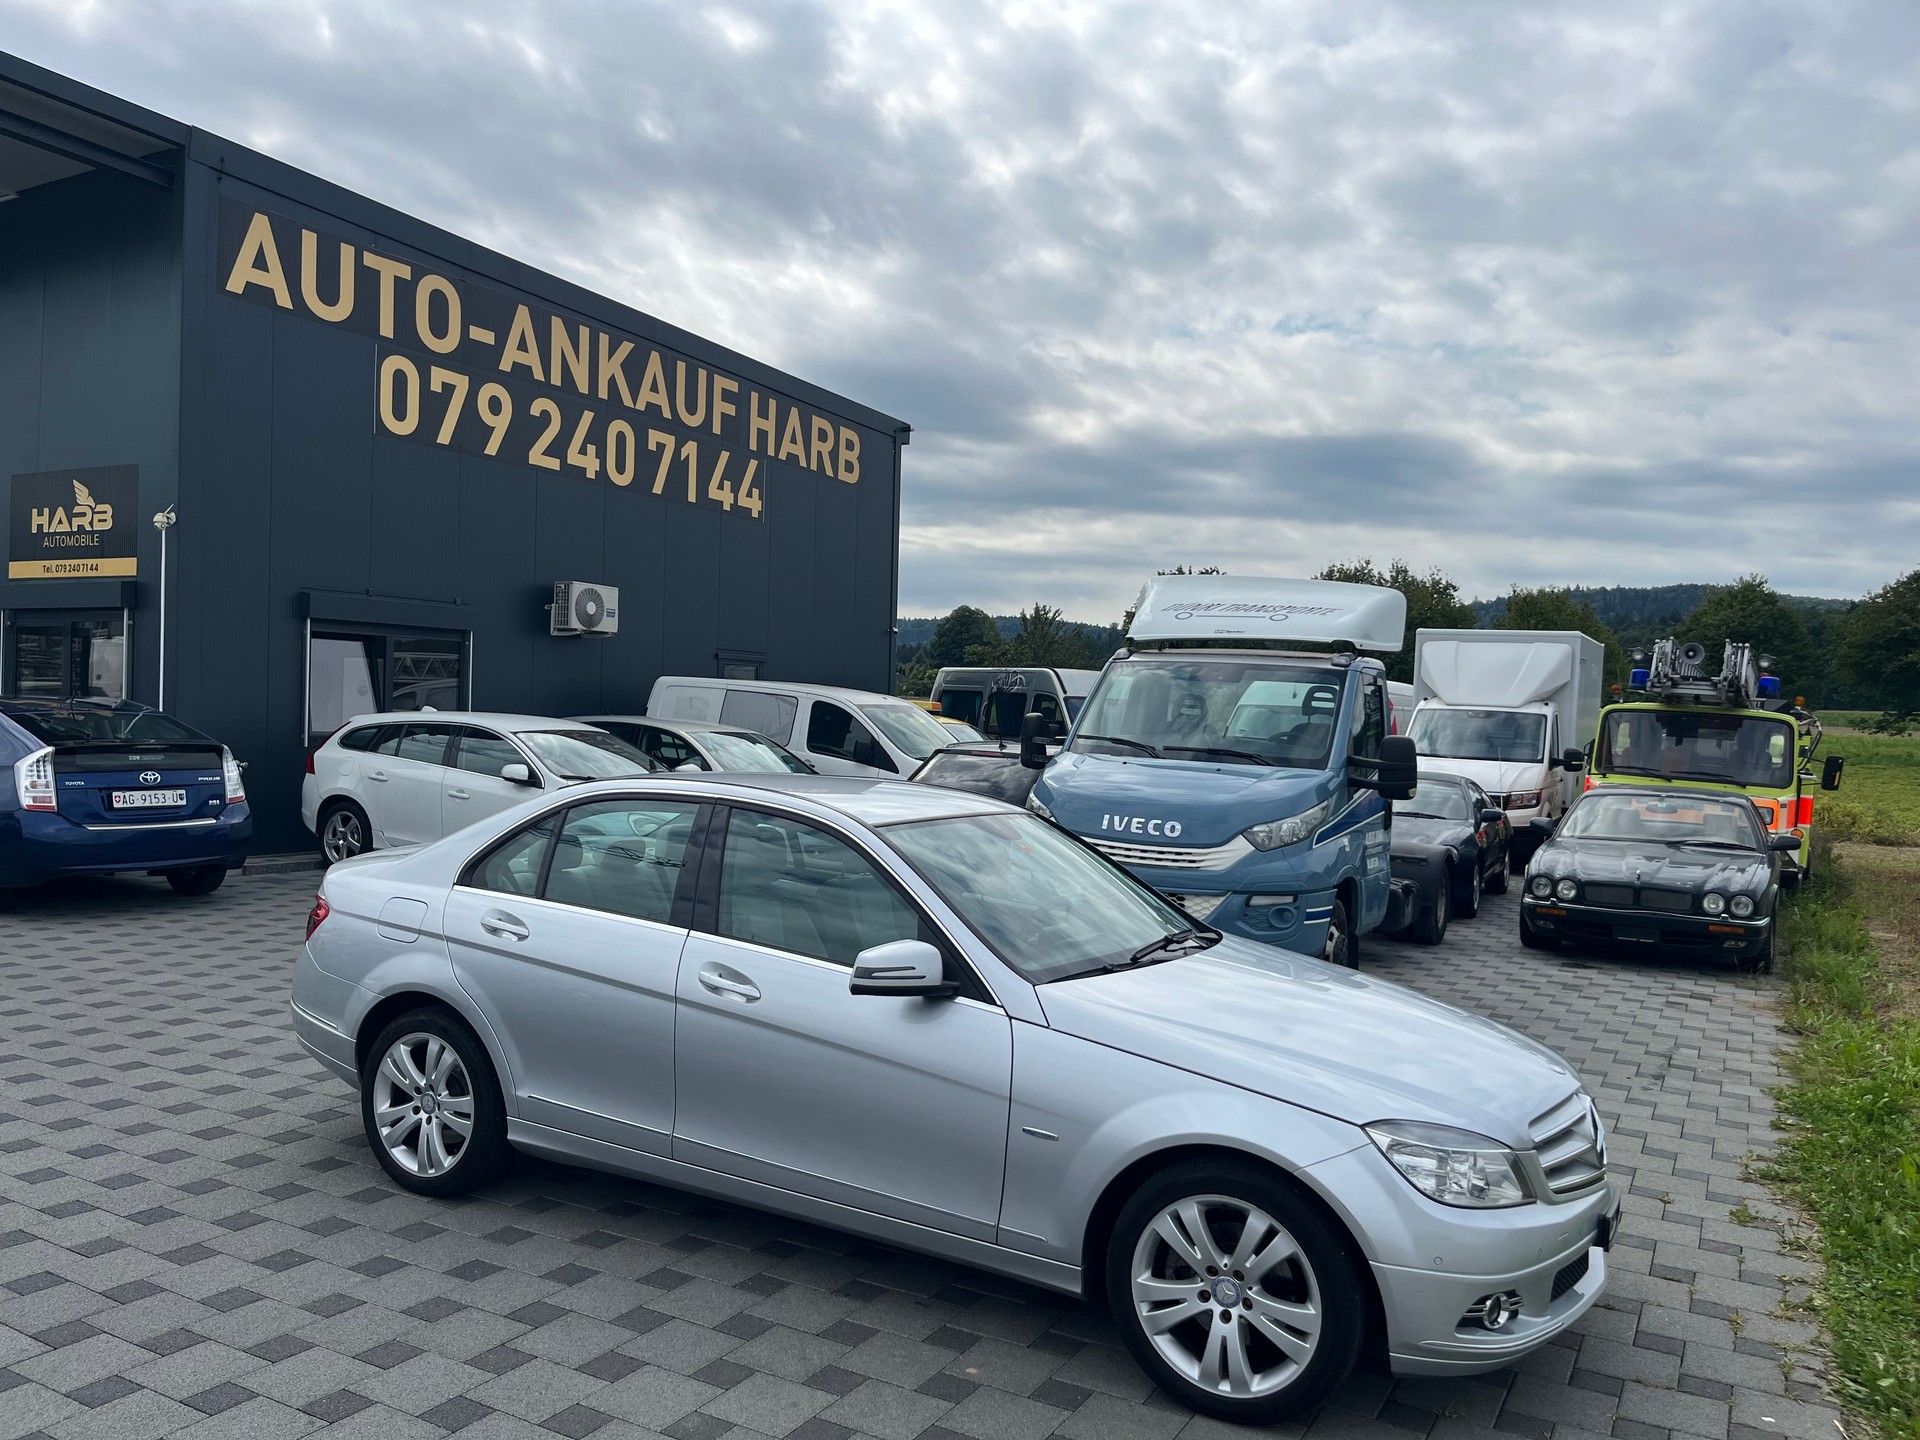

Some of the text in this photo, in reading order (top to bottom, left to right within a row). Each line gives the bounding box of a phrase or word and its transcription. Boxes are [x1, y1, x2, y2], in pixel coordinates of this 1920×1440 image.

[225, 212, 861, 484] AUTO-ANKAUF HARB
[379, 355, 762, 518] 079 240 7144
[31, 503, 113, 533] HARB
[43, 534, 99, 548] AUTOMOBILE
[42, 563, 99, 573] Tel. 079 240 7144
[1219, 603, 1343, 616] TRANSPORTE
[1101, 814, 1182, 838] IVECO
